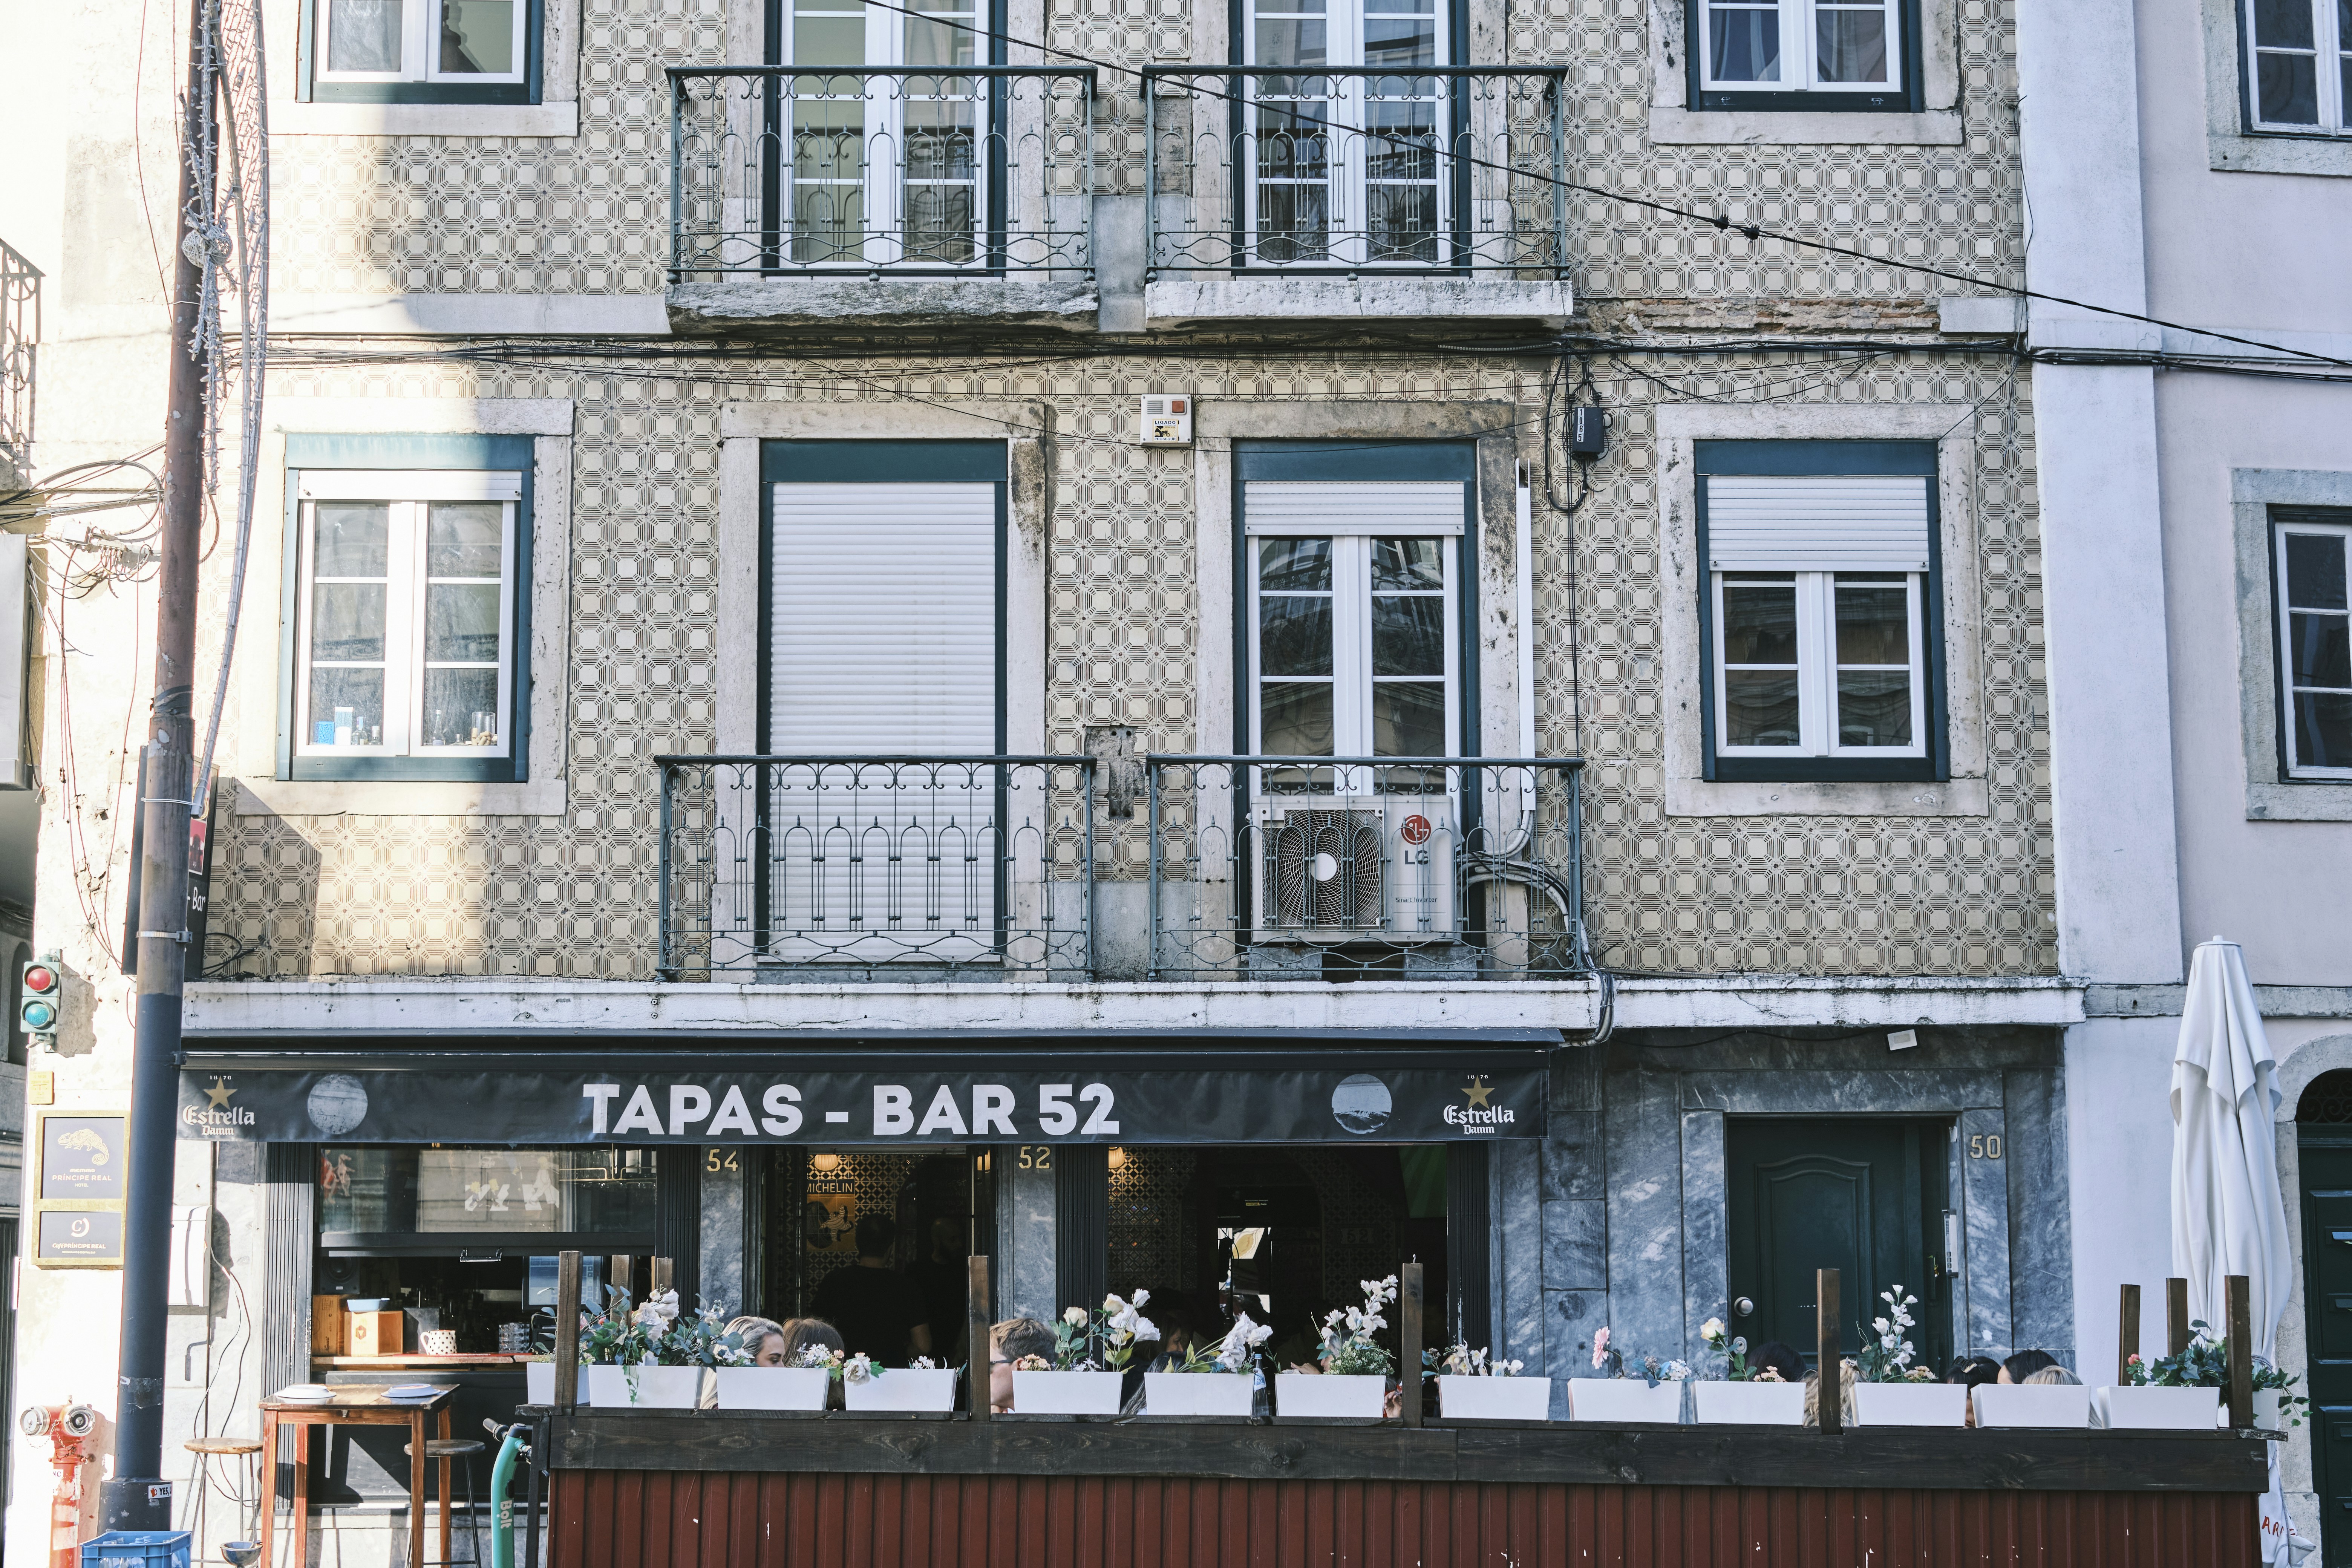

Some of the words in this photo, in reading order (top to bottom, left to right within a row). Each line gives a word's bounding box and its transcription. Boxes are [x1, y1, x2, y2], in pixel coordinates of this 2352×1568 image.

[1405, 850, 1429, 865] LG
[192, 886, 206, 912] Bar
[183, 1104, 255, 1125] Estrella
[583, 1084, 803, 1136] TAPAS
[873, 1084, 1018, 1135] BAR
[1039, 1083, 1119, 1135] 52
[1443, 1104, 1515, 1125] Estrella
[202, 1125, 234, 1136] Damm
[1463, 1124, 1495, 1135] Damm
[1018, 1146, 1050, 1170] 52
[1970, 1135, 2001, 1159] 50
[707, 1149, 739, 1172] 54
[159, 1487, 169, 1496] YES,
[500, 1500, 513, 1529] Bolt
